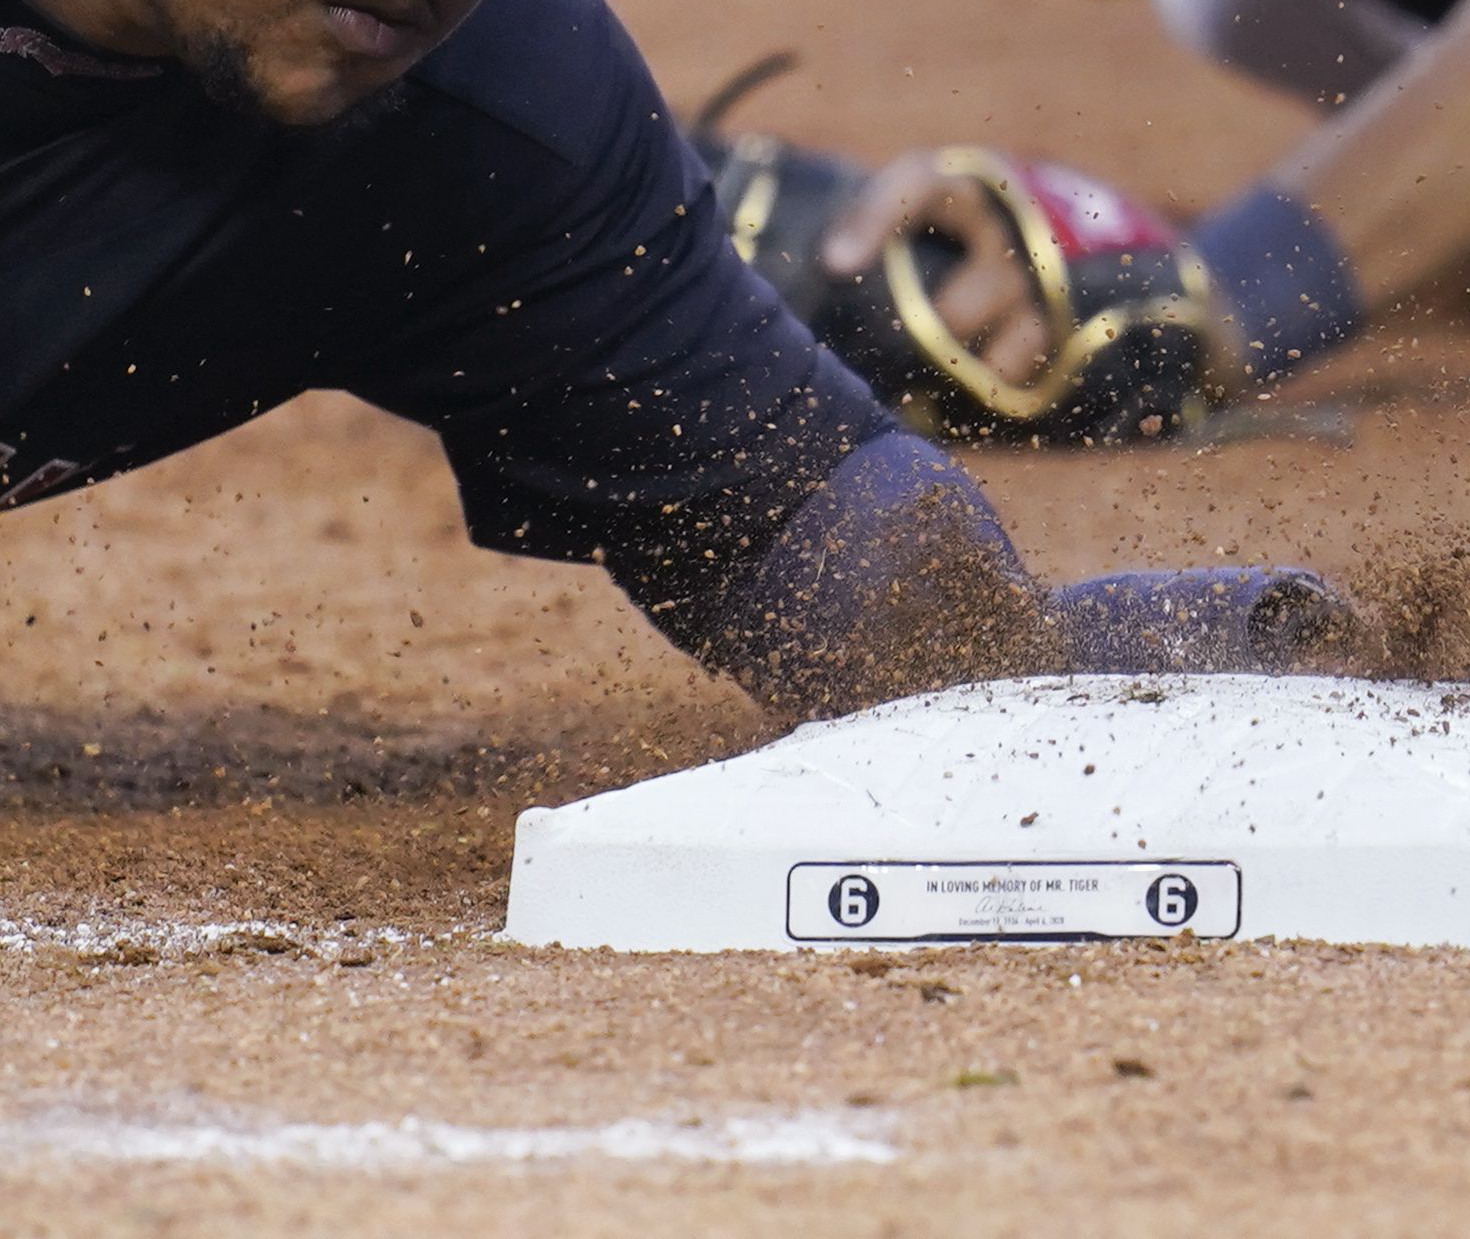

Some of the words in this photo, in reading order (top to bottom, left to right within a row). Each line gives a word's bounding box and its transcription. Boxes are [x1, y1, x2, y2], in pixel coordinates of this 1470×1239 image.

[839, 877, 868, 924] 6
[926, 880, 938, 893] IN
[941, 880, 979, 893] LOVING
[982, 879, 1027, 893] MEMORY
[1029, 879, 1043, 892] OF
[1045, 879, 1065, 892] MR.
[1069, 879, 1099, 892] TIGER
[1158, 876, 1187, 923] 6
